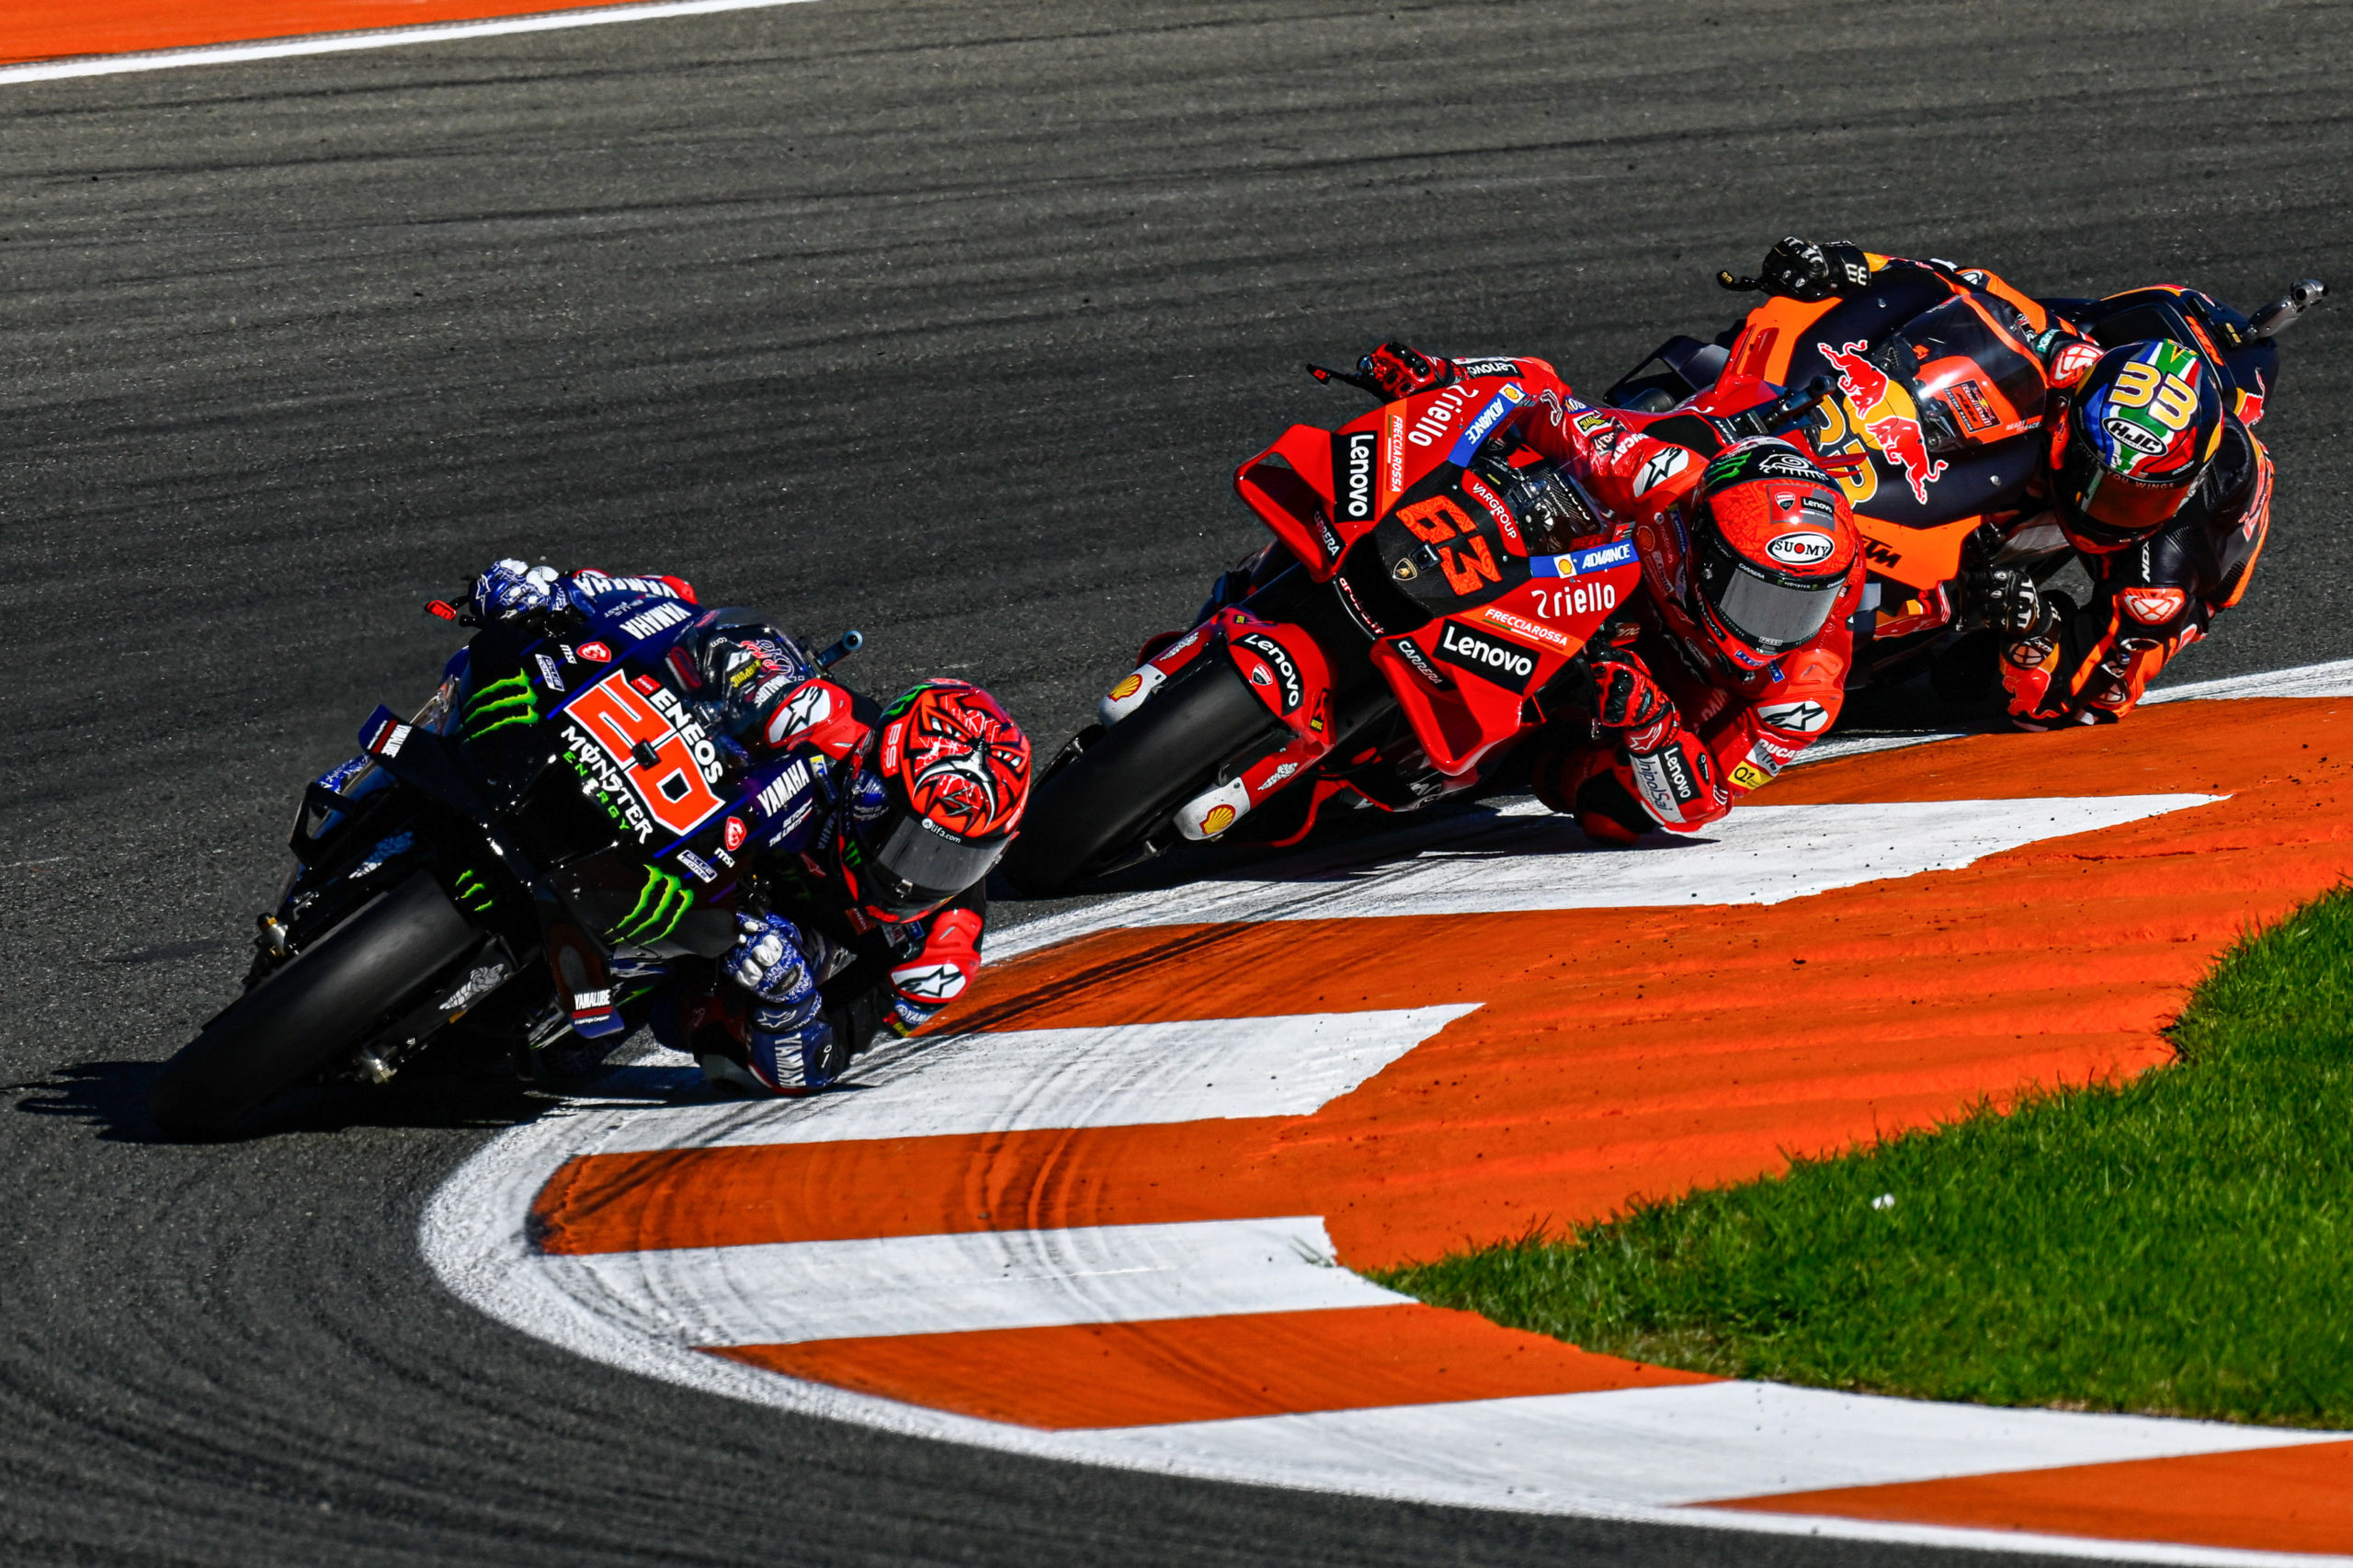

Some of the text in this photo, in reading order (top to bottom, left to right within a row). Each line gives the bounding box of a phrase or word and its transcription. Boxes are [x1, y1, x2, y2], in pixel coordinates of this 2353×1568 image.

[1467, 362, 1518, 376] Lenovo
[1944, 389, 1973, 431] FACTORY RACING
[2109, 360, 2200, 432] 33
[1465, 397, 1505, 445] ADVANCE
[2006, 419, 2027, 431] READY
[2109, 422, 2161, 451] HJC
[1348, 434, 1375, 517] Lenovo
[1391, 414, 1404, 494] FRECCIAROSSA
[1472, 483, 1518, 540] VARGROUP
[1802, 497, 1833, 514] Lenovo
[1396, 494, 1503, 597] 63
[1582, 543, 1631, 569] ADVANCE
[1774, 540, 1830, 557] SUOMY
[572, 576, 680, 599] YAMAHA
[1738, 562, 1765, 579] CARRERA
[619, 601, 692, 641] YAMAHA
[1484, 608, 1568, 647] FRECCIAROSSA
[560, 644, 578, 665] msi
[1244, 633, 1300, 707] Lenovo
[1397, 640, 1443, 685] CARRERA
[1442, 625, 1533, 676] Lenovo
[563, 668, 727, 835] 20
[655, 687, 724, 786] ENEOS
[561, 725, 654, 844] MONSTER
[563, 750, 630, 831] ENRGY
[756, 758, 811, 819] YAMAHA
[1664, 746, 1692, 799] Lenovo
[685, 851, 715, 877] BLUE
[713, 846, 736, 869] msi
[574, 988, 611, 1011] YAMALUBE
[774, 1031, 807, 1088] YAMAH
